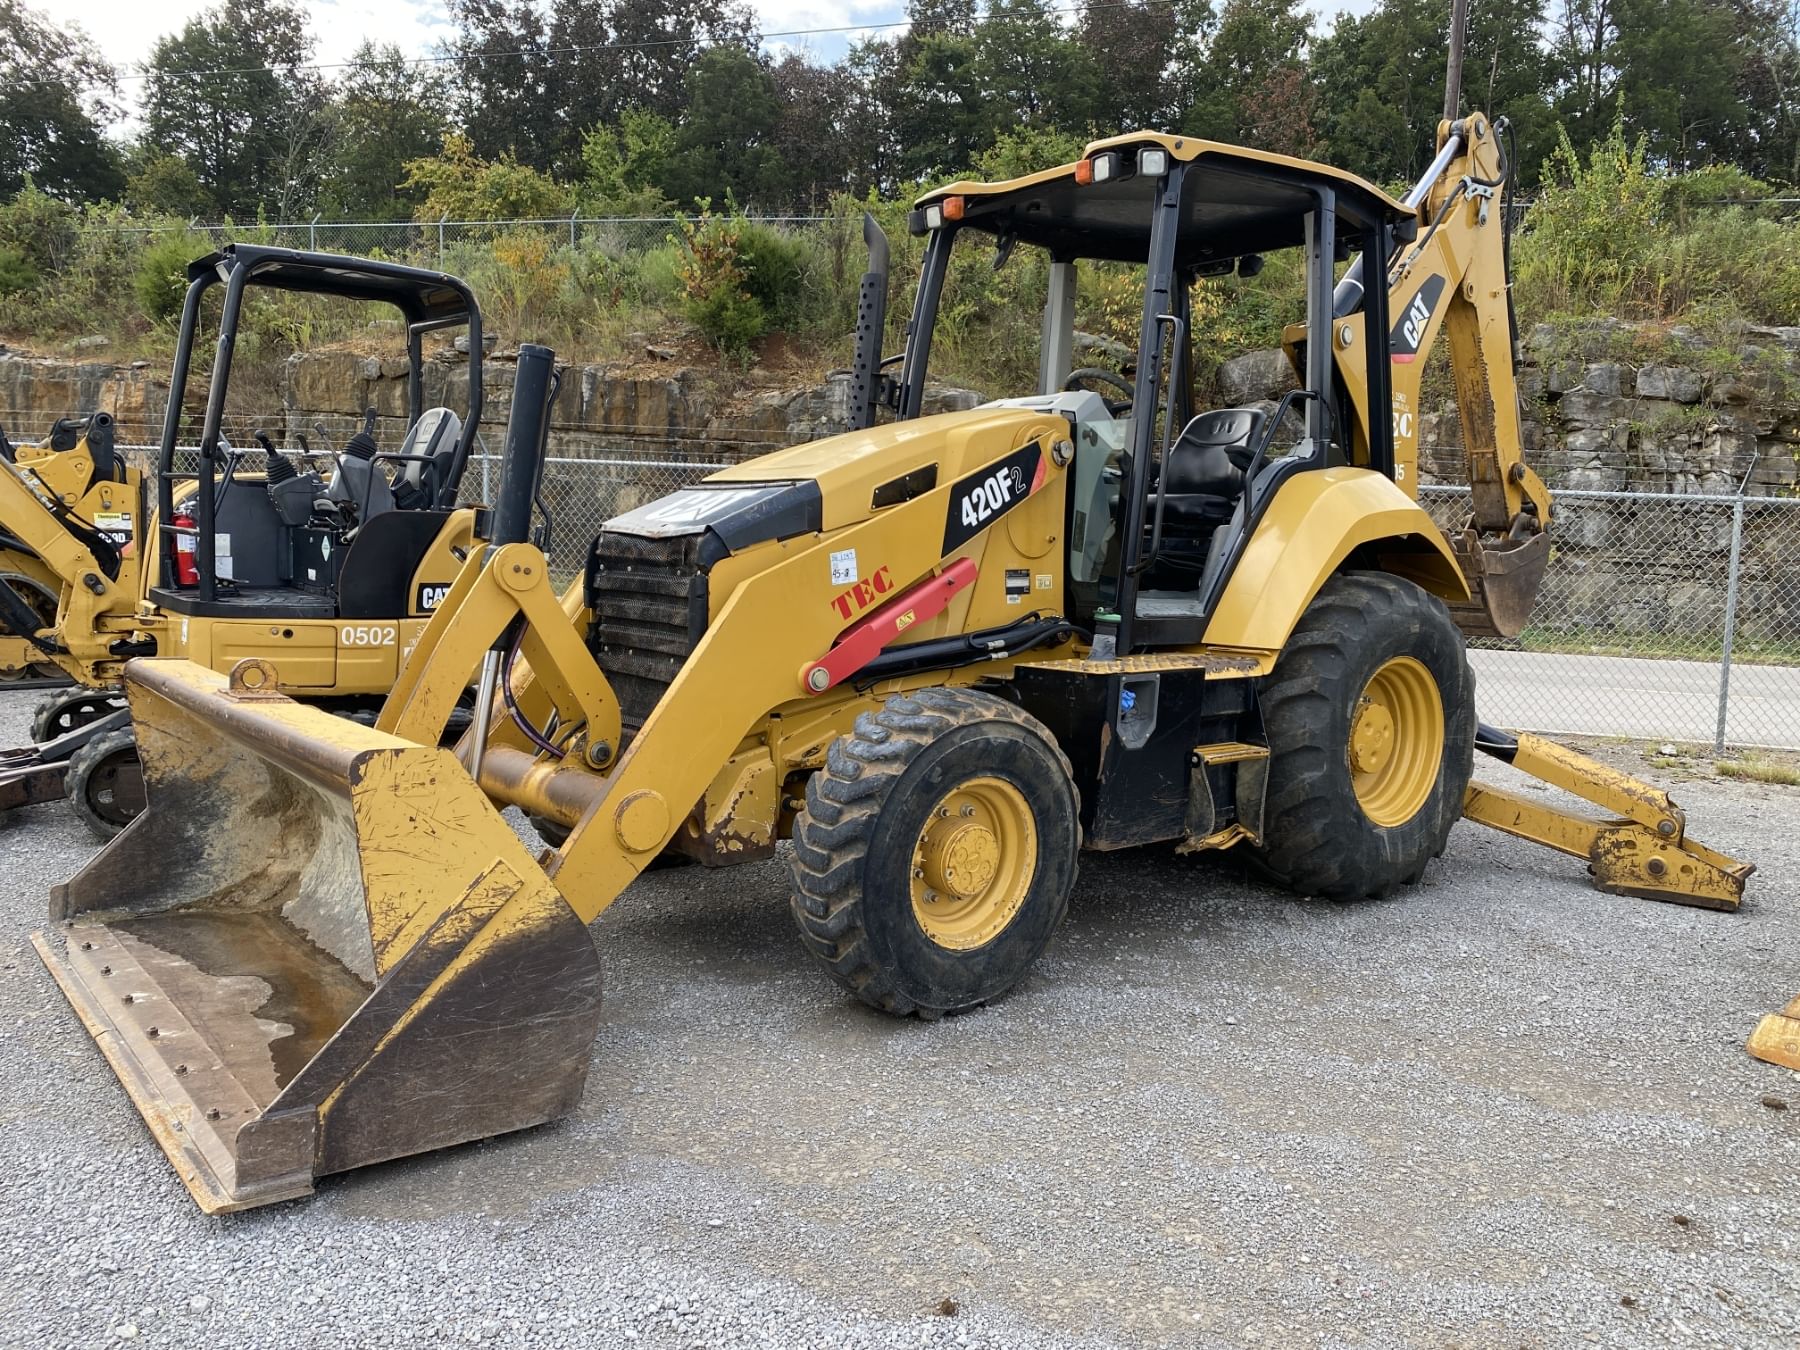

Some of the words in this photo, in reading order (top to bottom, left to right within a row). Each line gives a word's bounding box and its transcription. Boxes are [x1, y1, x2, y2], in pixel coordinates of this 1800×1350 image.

[1403, 291, 1430, 349] CAT
[644, 490, 762, 522] CAT
[961, 466, 1027, 527] 420F2
[831, 565, 894, 620] TEC
[341, 626, 395, 646] 0502
